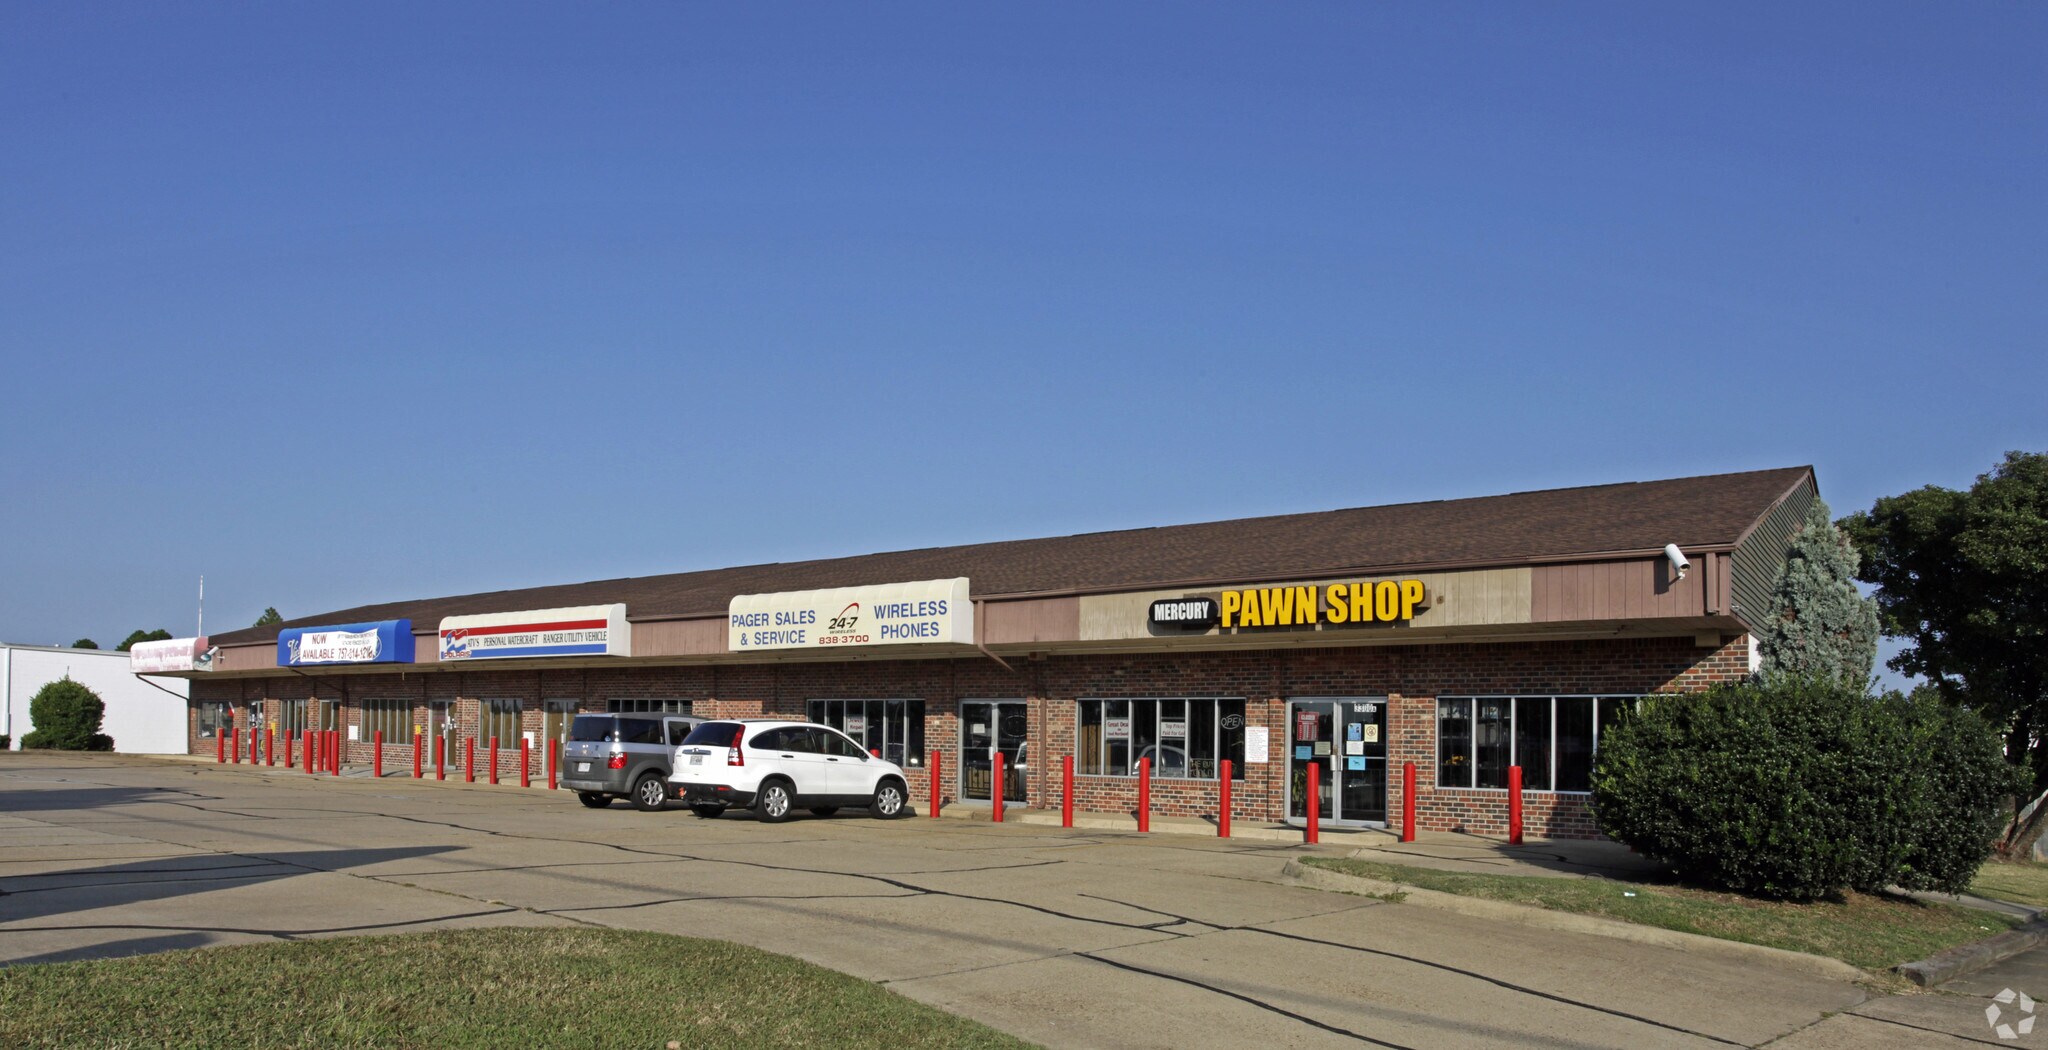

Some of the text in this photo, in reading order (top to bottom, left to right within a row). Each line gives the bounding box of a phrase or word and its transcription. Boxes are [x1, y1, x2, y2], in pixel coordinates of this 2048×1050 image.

[874, 599, 948, 620] WIRELESS
[1154, 601, 1210, 621] MERCURY
[1221, 579, 1424, 627] PAWN SHOP
[731, 609, 816, 628] PAGER SALES
[828, 616, 858, 630] 24-7
[484, 636, 507, 647] PERSONAL
[507, 634, 538, 646] WATERCRAFT
[543, 632, 564, 643] RANGER
[564, 631, 584, 643] UTILITY
[585, 630, 608, 642] VEHICLE
[740, 629, 806, 646] & SERVICE
[881, 621, 940, 639] PHONES
[311, 633, 327, 645] NOW
[302, 648, 335, 660] AVAILABLE
[1221, 716, 1245, 727] OPEN
